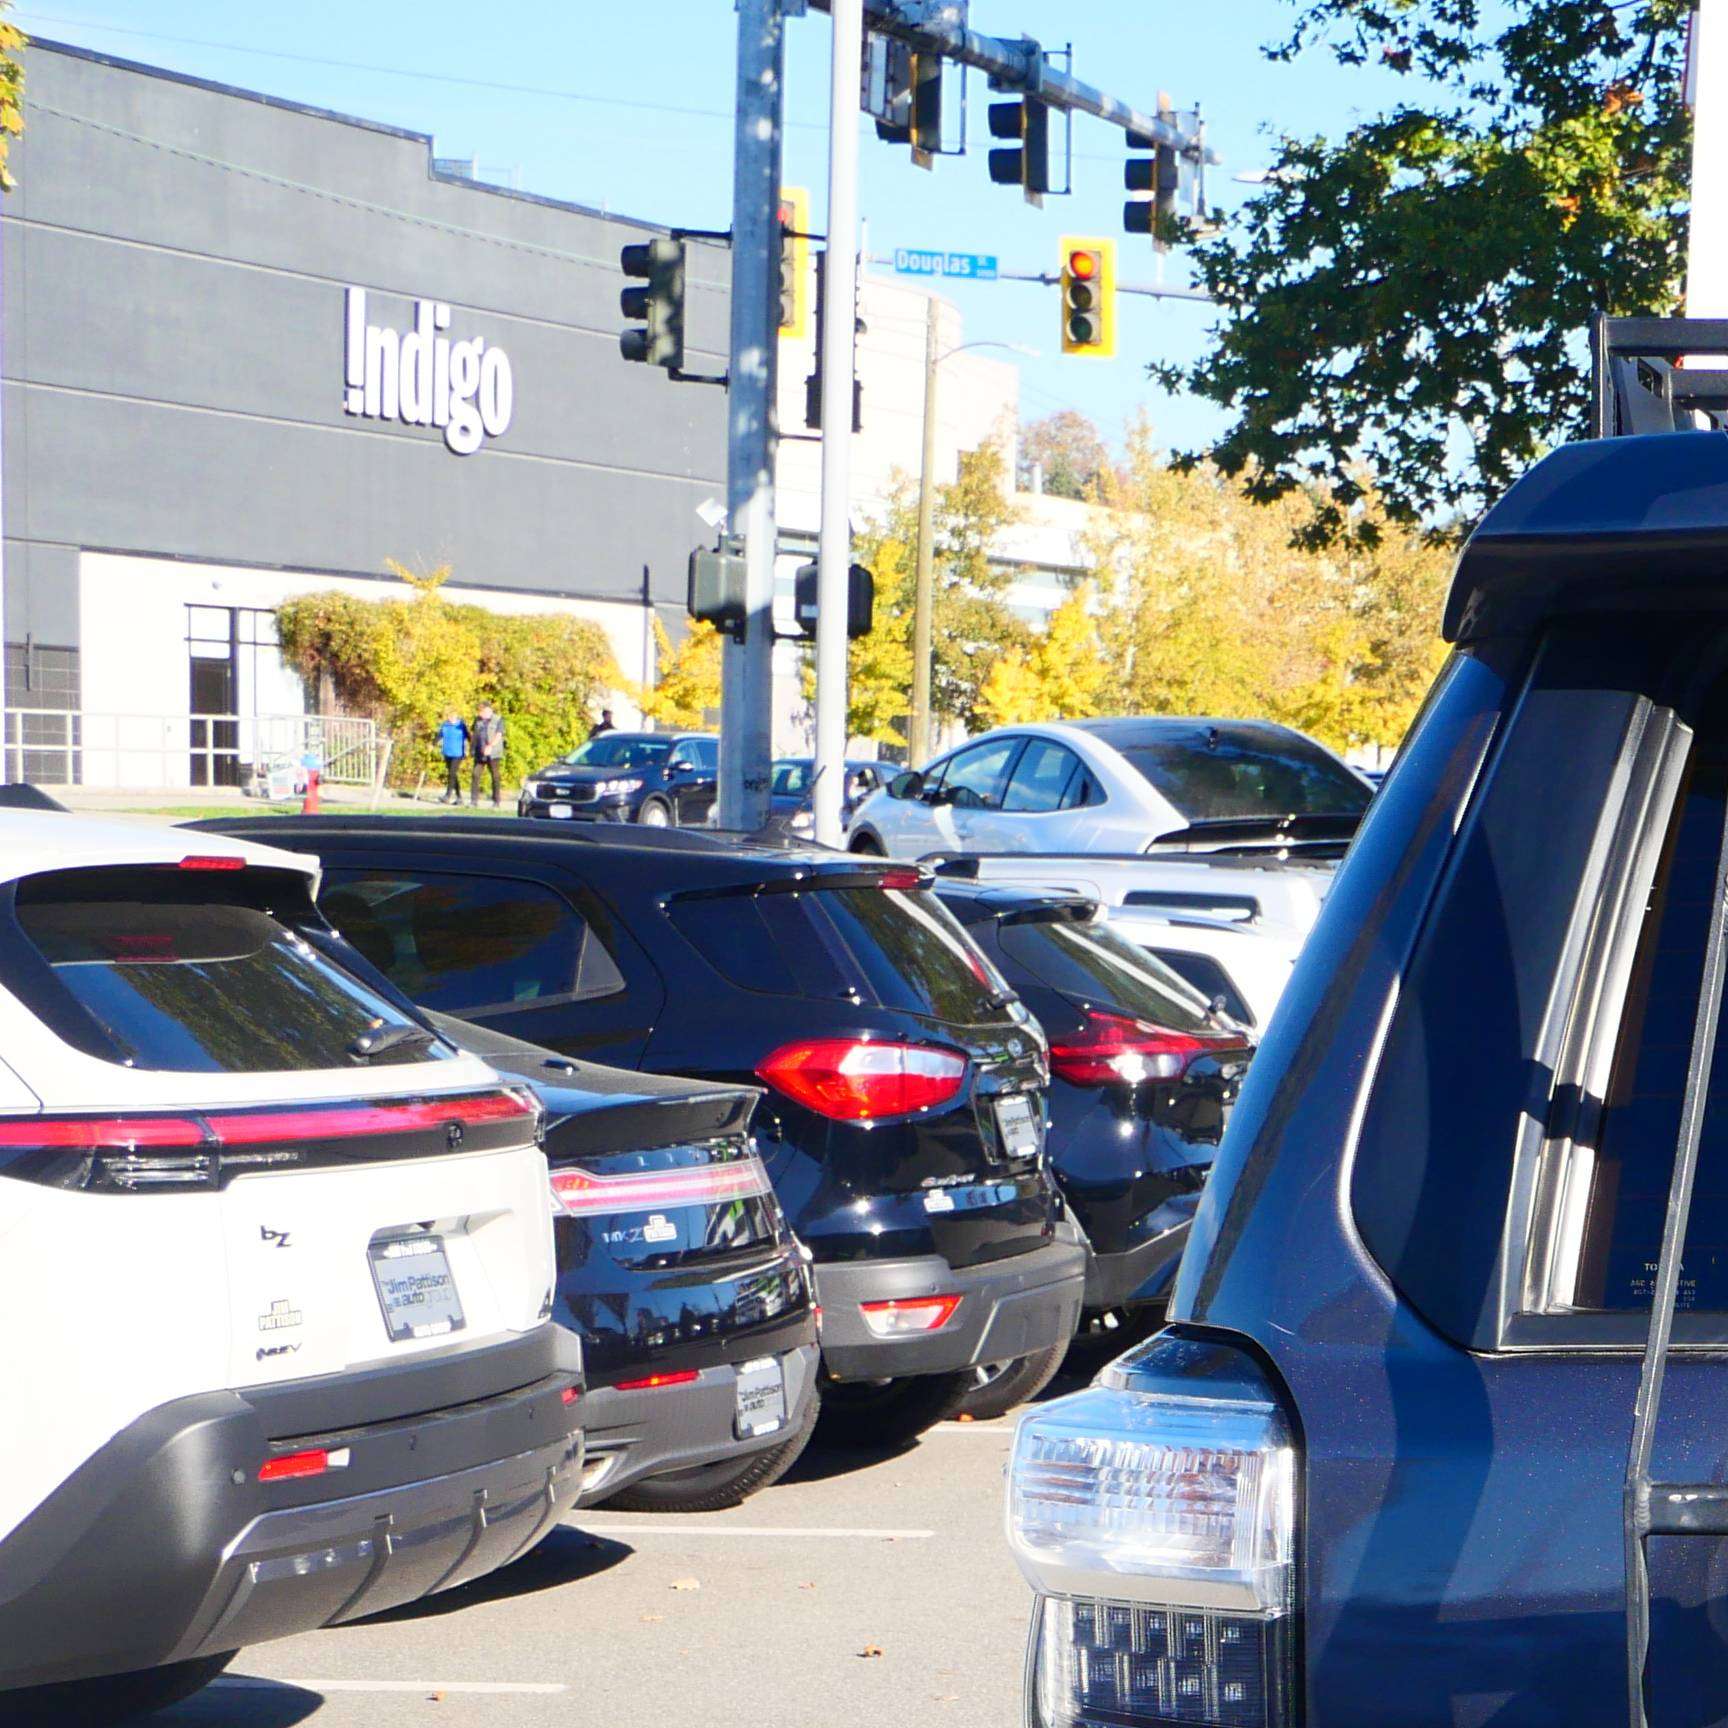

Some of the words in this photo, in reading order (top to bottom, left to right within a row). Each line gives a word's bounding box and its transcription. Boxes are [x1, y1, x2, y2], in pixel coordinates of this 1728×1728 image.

[898, 250, 971, 277] Douglas
[346, 286, 513, 455] Indigo
[1644, 1263, 1685, 1271] TOA
